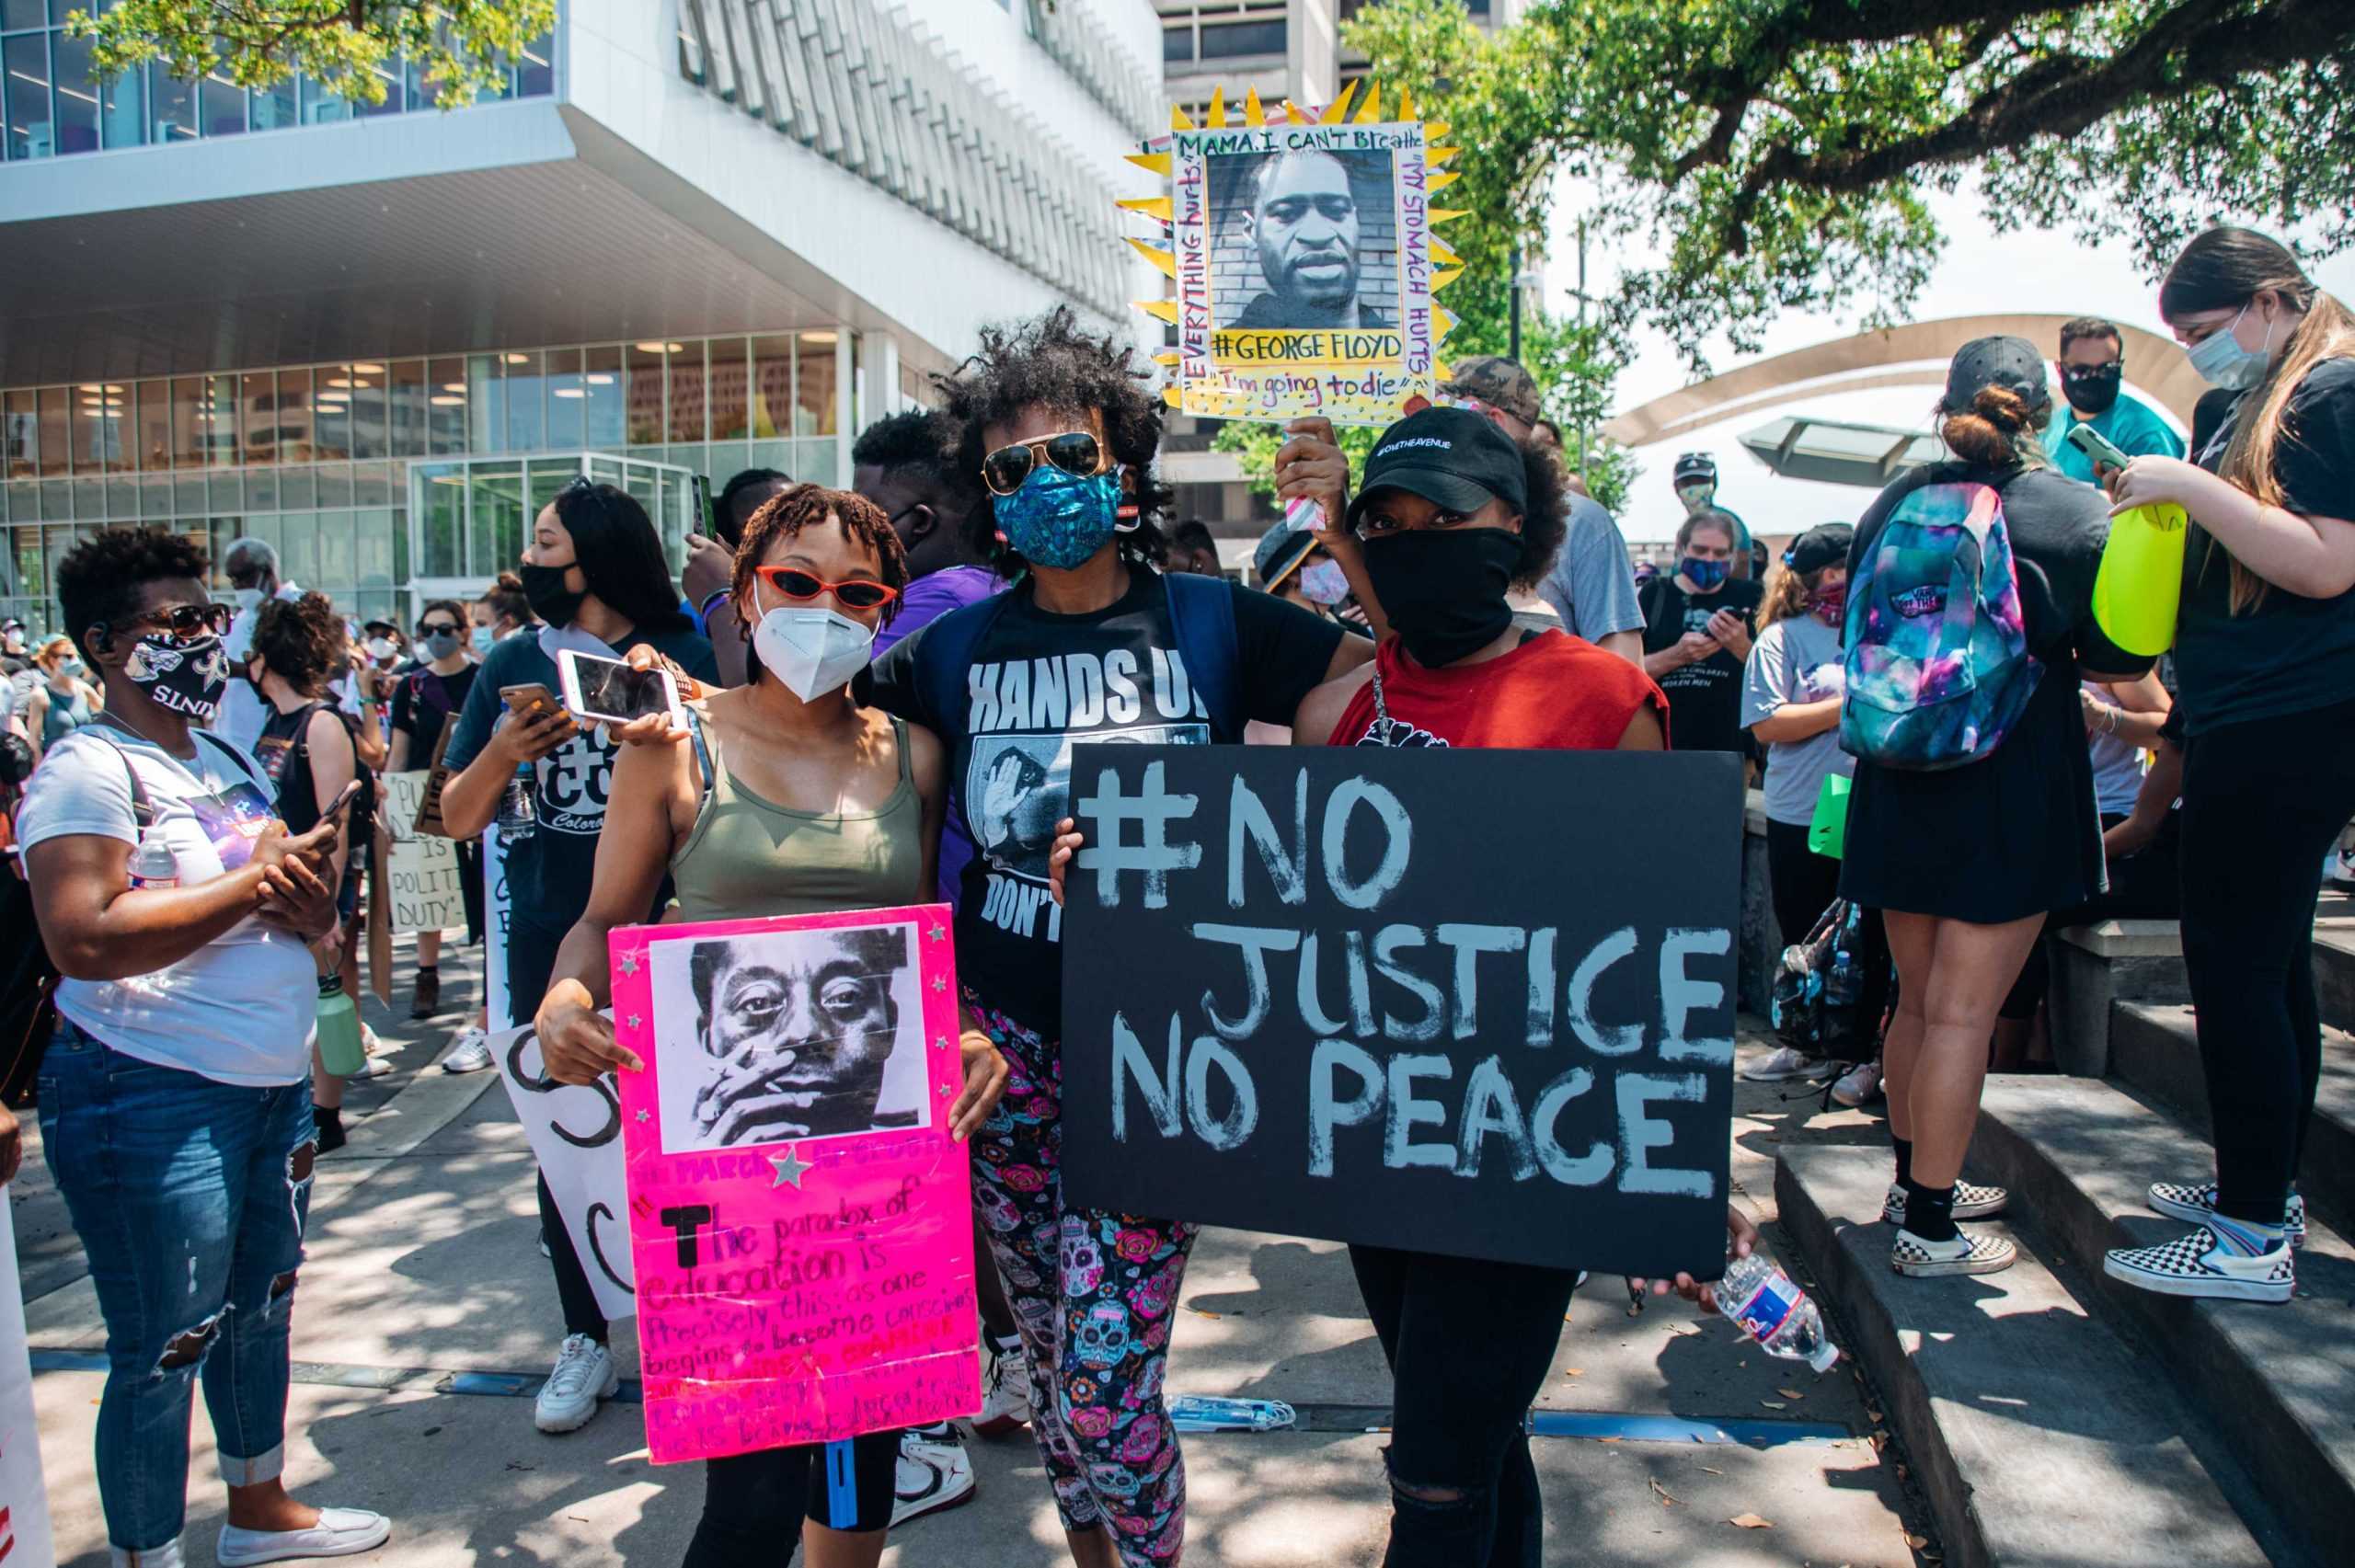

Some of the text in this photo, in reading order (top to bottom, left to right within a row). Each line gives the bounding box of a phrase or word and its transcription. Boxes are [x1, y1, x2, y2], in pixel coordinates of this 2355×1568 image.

[1288, 127, 1348, 150] CAN'T
[1403, 195, 1426, 296] STOMACH
[1211, 333, 1402, 361] #GEORGE FLOYD
[1261, 372, 1323, 408] going
[968, 648, 1141, 734] HANDS
[423, 840, 447, 858] IS
[1076, 760, 1414, 911] #NO
[981, 874, 1062, 943] DON'T
[1193, 922, 1737, 1065] JUSTICE
[1111, 1011, 1716, 1198] NO PEACE
[773, 1196, 873, 1265] paradox
[885, 1173, 921, 1217] of
[645, 1232, 889, 1310] education is
[845, 1282, 877, 1303] as
[881, 1270, 927, 1296] one
[645, 1344, 734, 1378] begins
[772, 1313, 875, 1350] become
